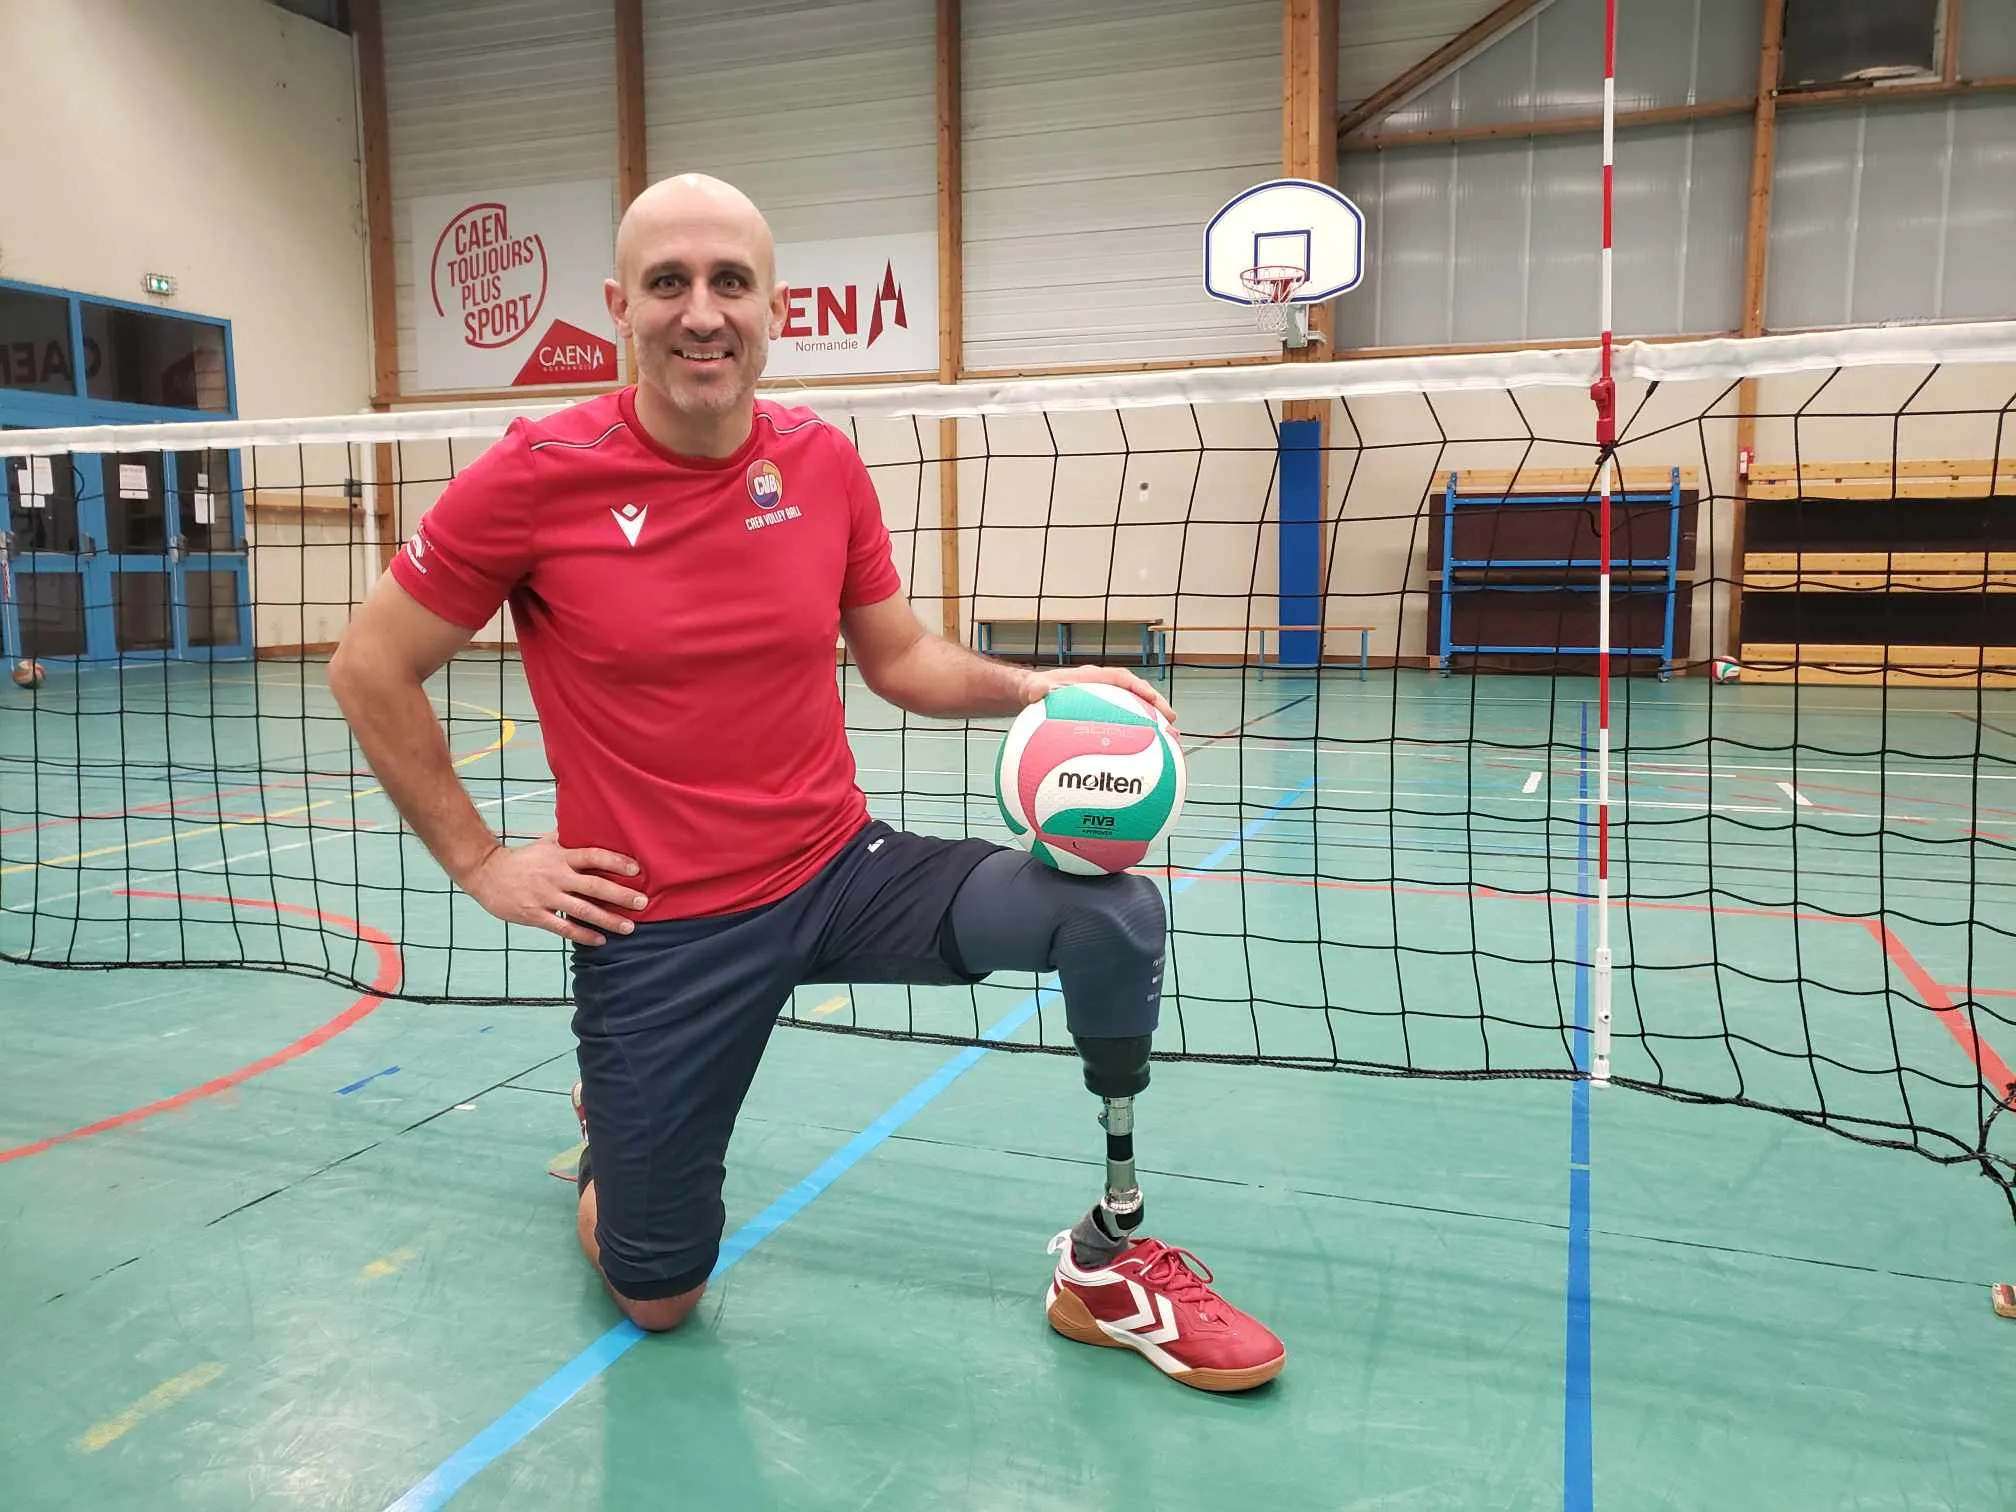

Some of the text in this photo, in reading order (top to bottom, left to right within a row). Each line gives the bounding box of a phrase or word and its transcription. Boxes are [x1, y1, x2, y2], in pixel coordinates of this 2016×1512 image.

[448, 236, 534, 287] TOUJOURS
[462, 277, 501, 310] PLUS
[464, 294, 532, 344] SPORT
[781, 285, 857, 337] EN
[539, 345, 591, 366] CAEN
[795, 339, 858, 353] Normandie
[763, 509, 786, 526] VOLLEY
[1058, 772, 1142, 795] molten
[1083, 815, 1114, 826] FIVB
